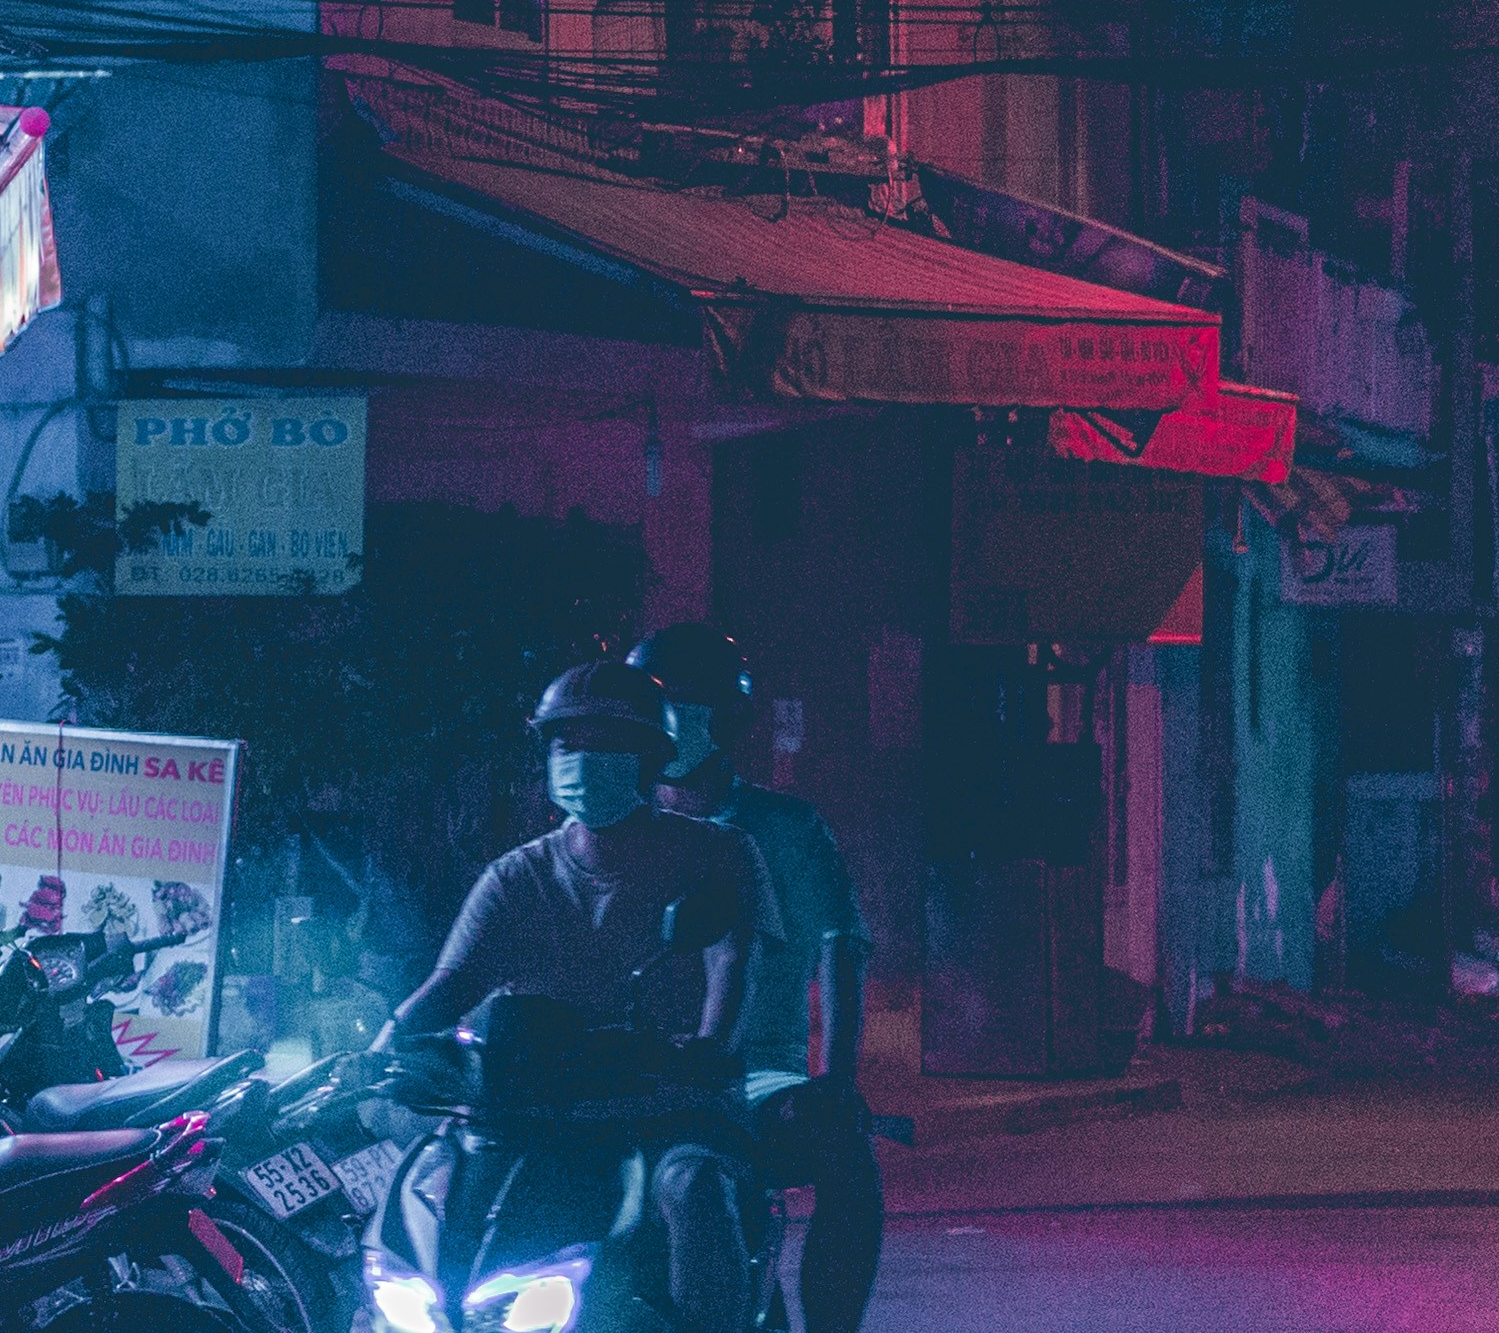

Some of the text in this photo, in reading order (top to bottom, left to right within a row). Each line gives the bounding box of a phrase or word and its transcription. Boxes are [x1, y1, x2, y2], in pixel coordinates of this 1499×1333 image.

[135, 407, 348, 446] PHỞ BÒ
[19, 740, 47, 766] ĂN
[53, 748, 85, 770] GIA
[90, 748, 139, 775] ĐÌNH
[144, 756, 181, 781] SA
[187, 758, 225, 784] KÊ
[109, 786, 140, 818] LẨU
[144, 792, 178, 822] CÁC
[5, 819, 43, 849] CÁC
[98, 827, 126, 857] ĂN
[131, 835, 163, 860] GIA
[253, 1147, 312, 1189] 55-X2
[273, 1169, 330, 1212] 2536
